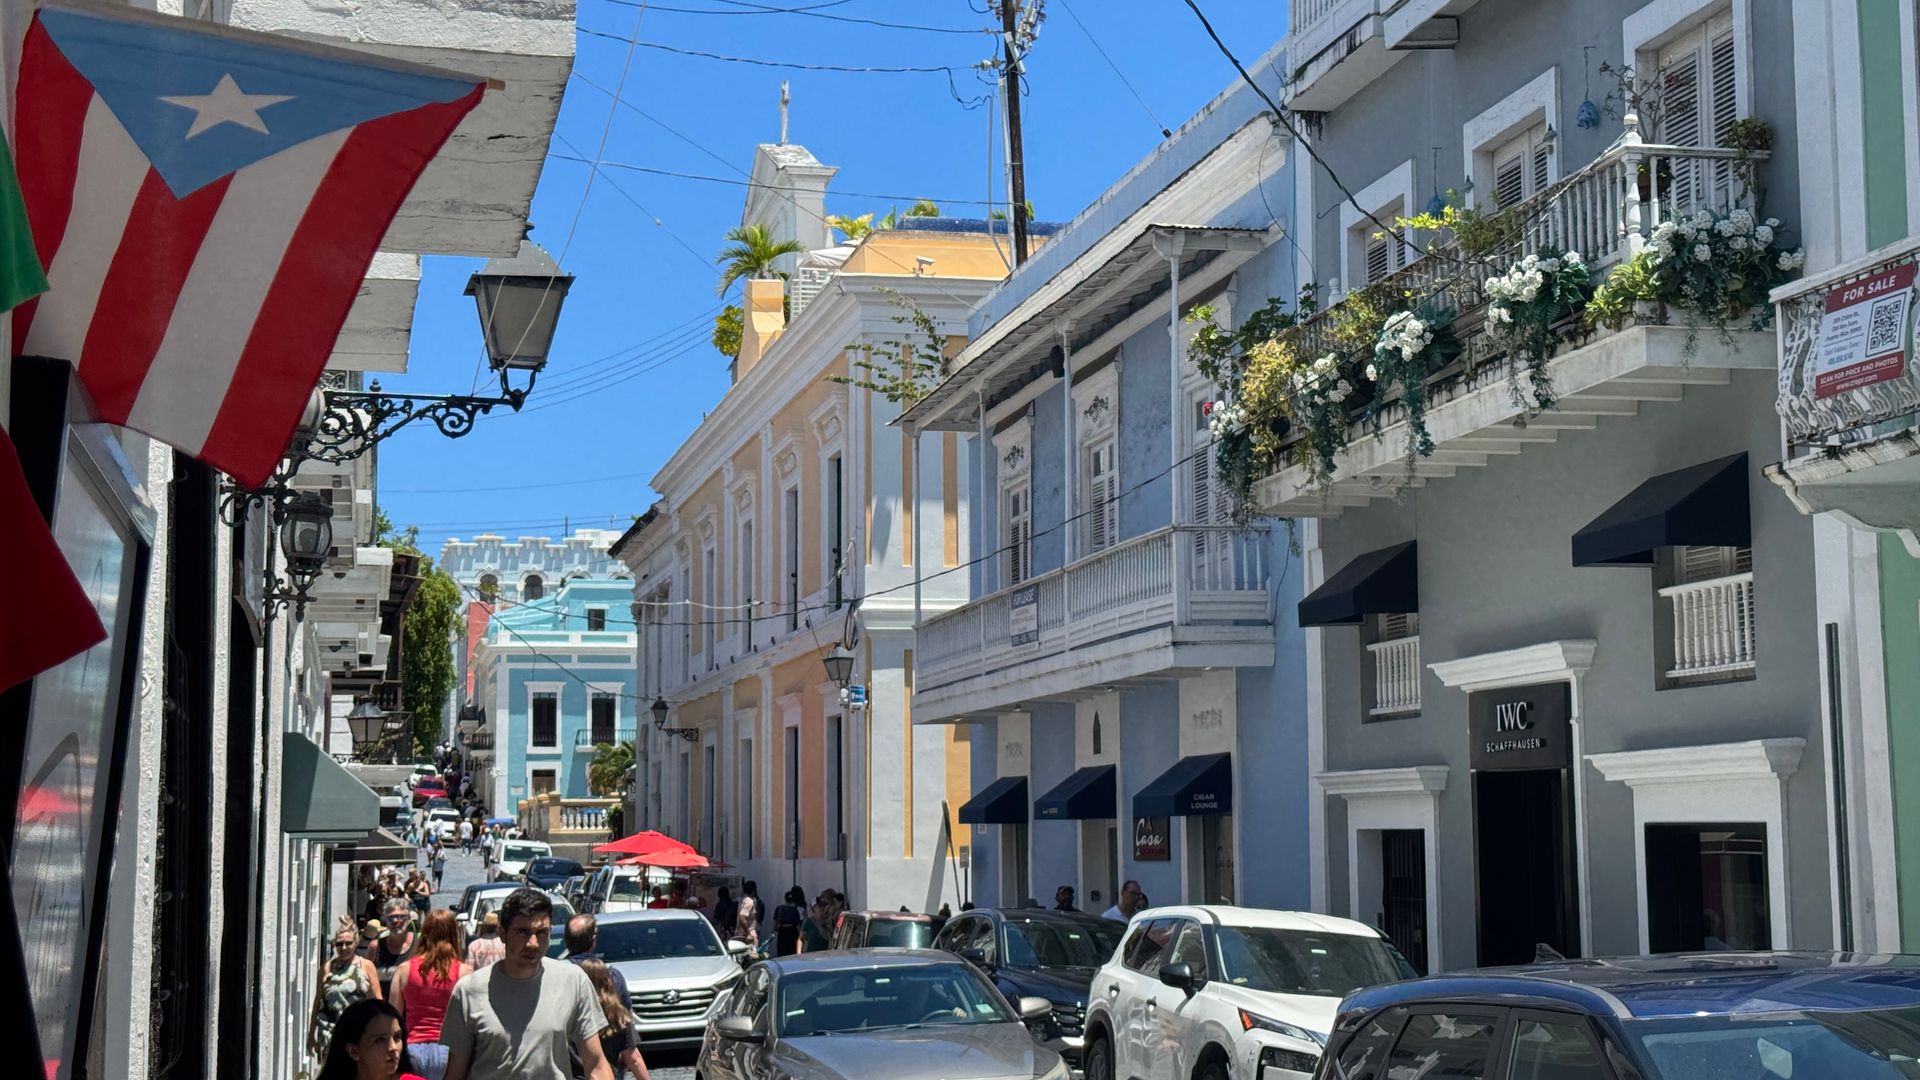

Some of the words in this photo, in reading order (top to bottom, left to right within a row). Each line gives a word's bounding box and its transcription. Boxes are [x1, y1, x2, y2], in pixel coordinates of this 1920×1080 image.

[1842, 286, 1865, 304] FOR
[1867, 275, 1897, 295] SALE
[1820, 374, 1834, 385] SCAN
[1834, 371, 1845, 381] FOR
[1845, 366, 1861, 377] PRICE
[1861, 363, 1874, 372] AND
[1874, 356, 1898, 369] PHOTOS
[1021, 588, 1034, 604] LEASE
[1496, 701, 1528, 732] IWC
[1486, 738, 1541, 753] SCHAFFHAUSEN
[1190, 801, 1218, 809] LOUNGE
[1193, 793, 1215, 801] CIGAR
[1135, 817, 1164, 847] Casa
